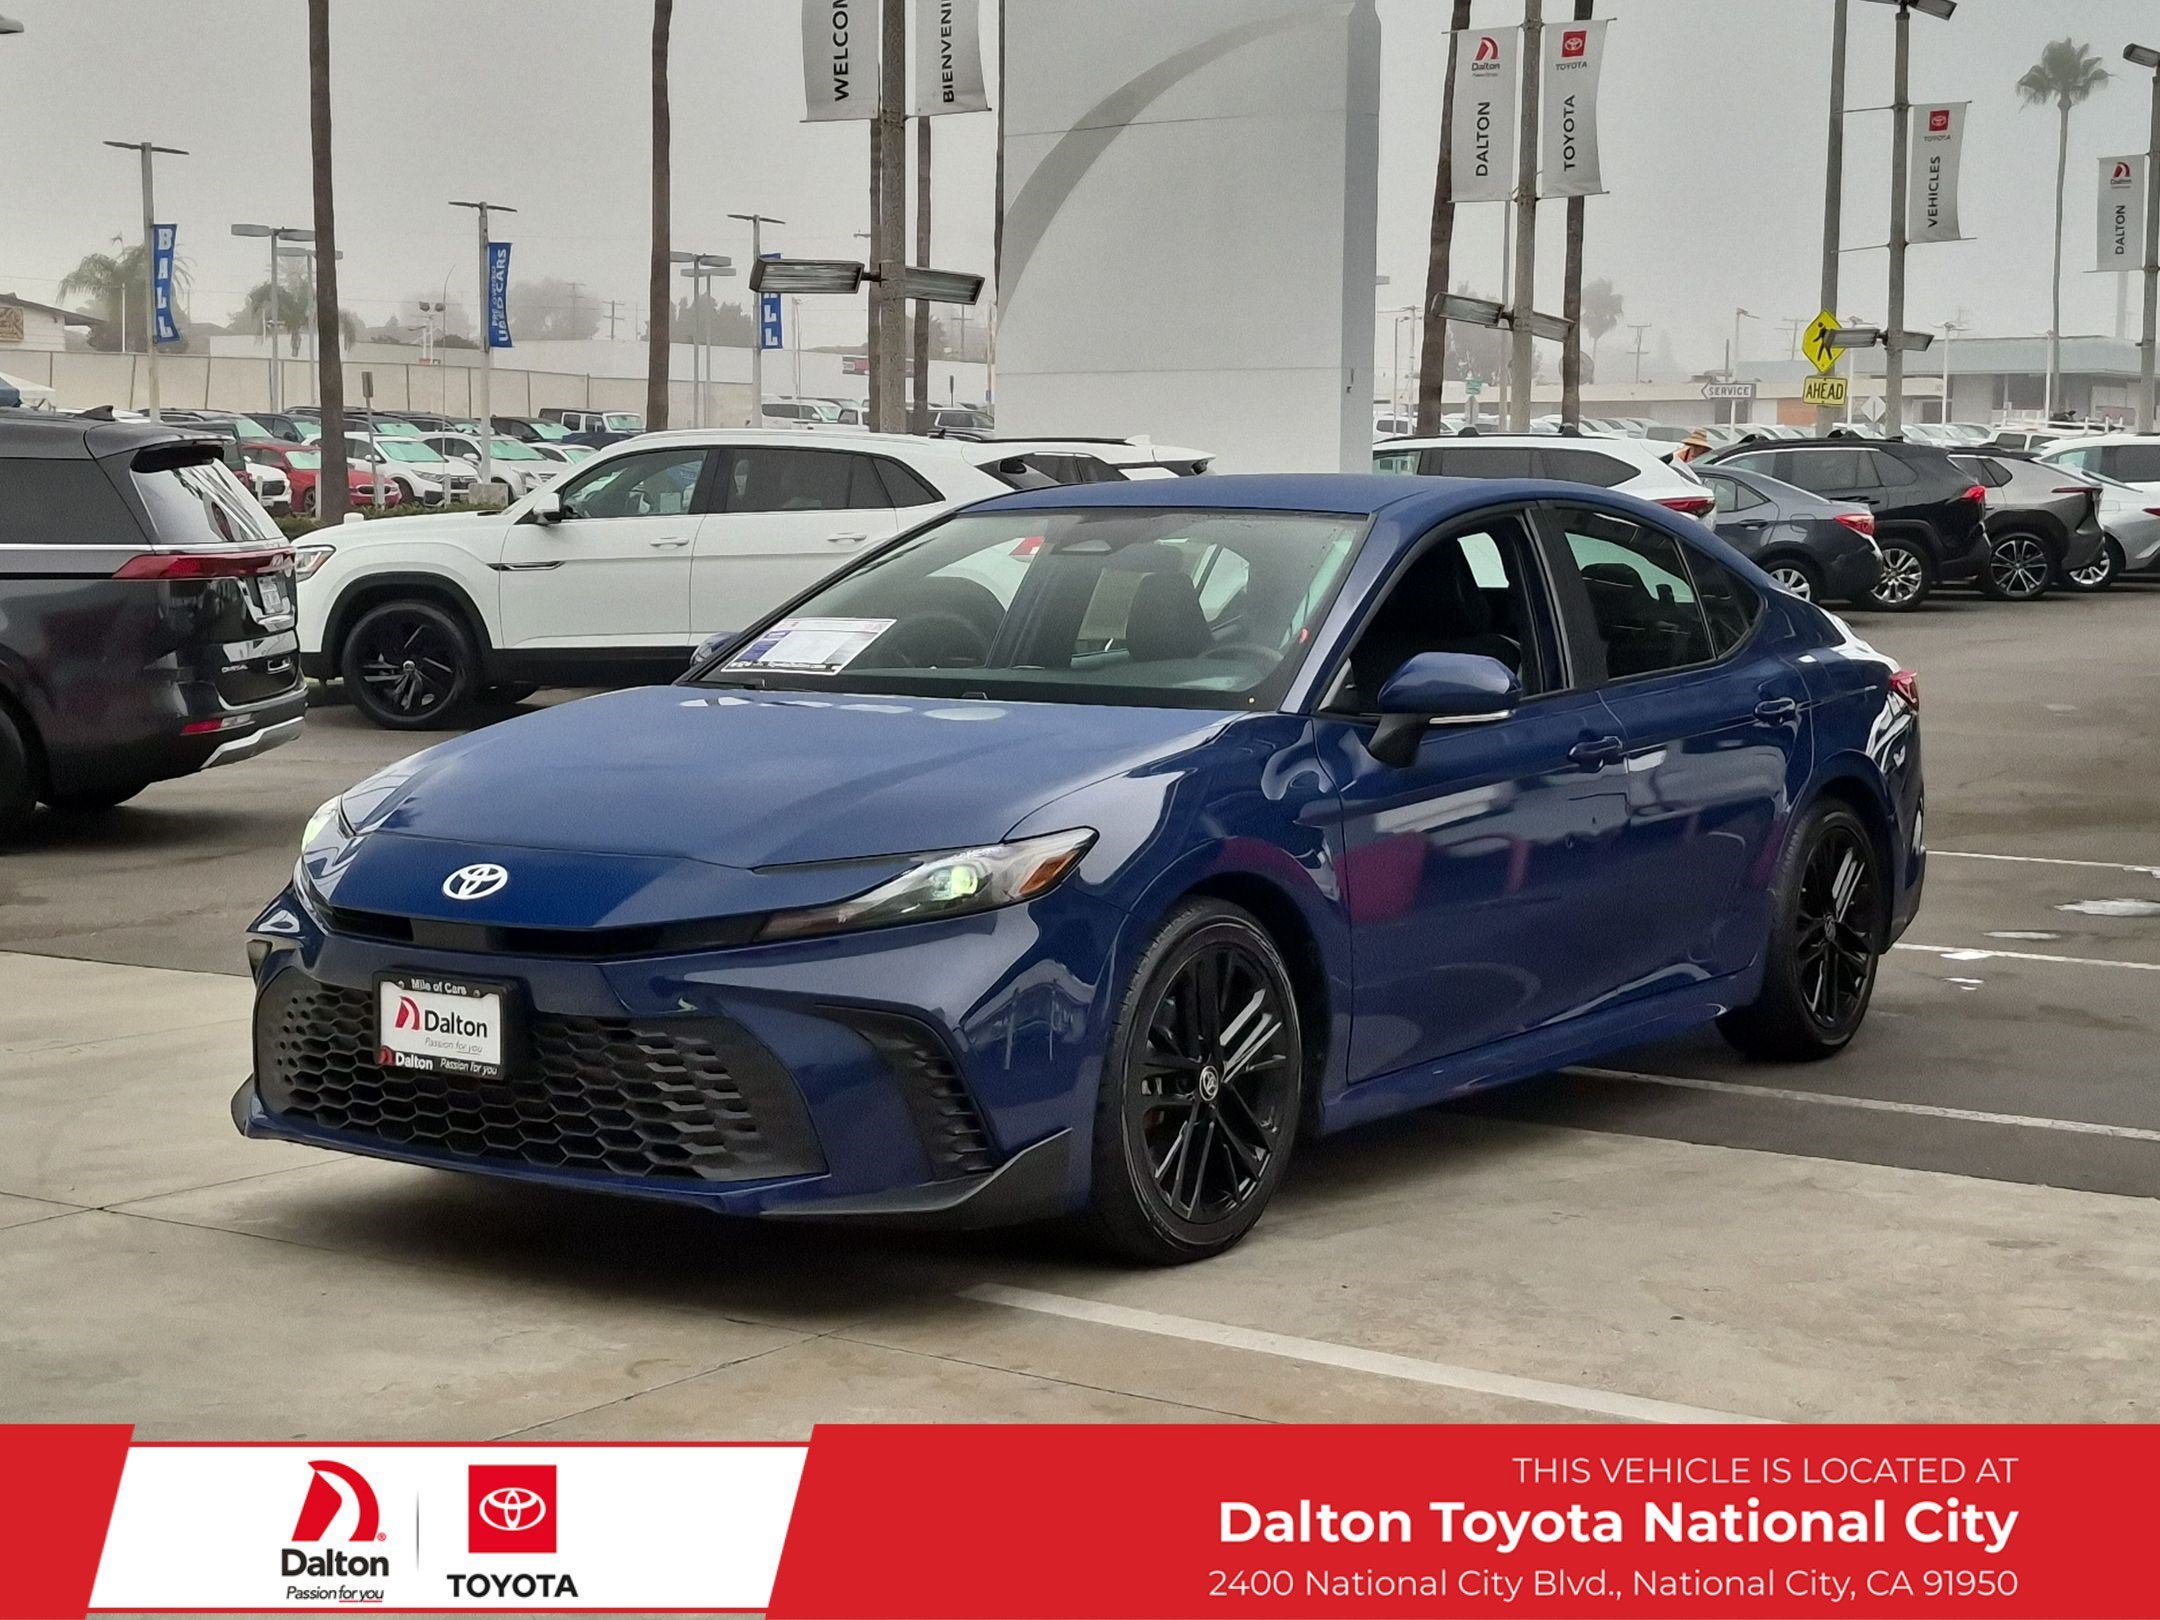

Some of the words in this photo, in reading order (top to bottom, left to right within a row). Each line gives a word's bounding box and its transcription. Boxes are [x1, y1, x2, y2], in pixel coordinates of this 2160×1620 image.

[941, 0, 954, 103] BIENVENI
[1472, 62, 1500, 71] Dalton
[1555, 61, 1588, 71] TOYOTA
[1476, 102, 1490, 176] DALTON
[1563, 95, 1576, 172] TOYOTA
[1927, 156, 1941, 228] VEHICLES
[2115, 205, 2125, 255] DALTON
[496, 248, 507, 293] CARS
[1708, 385, 1750, 396] SERVICE
[1806, 382, 1844, 399] AHEAD
[411, 978, 431, 991] Mile
[433, 981, 443, 992] of
[444, 983, 467, 995] Cars
[424, 1009, 488, 1038] Dalton
[424, 1037, 454, 1050] Passion
[456, 1041, 468, 1051] for
[468, 1044, 483, 1053] you
[395, 1052, 434, 1070] Dalton
[440, 1058, 469, 1072] Passion
[470, 1062, 481, 1072] for
[482, 1065, 498, 1075] you
